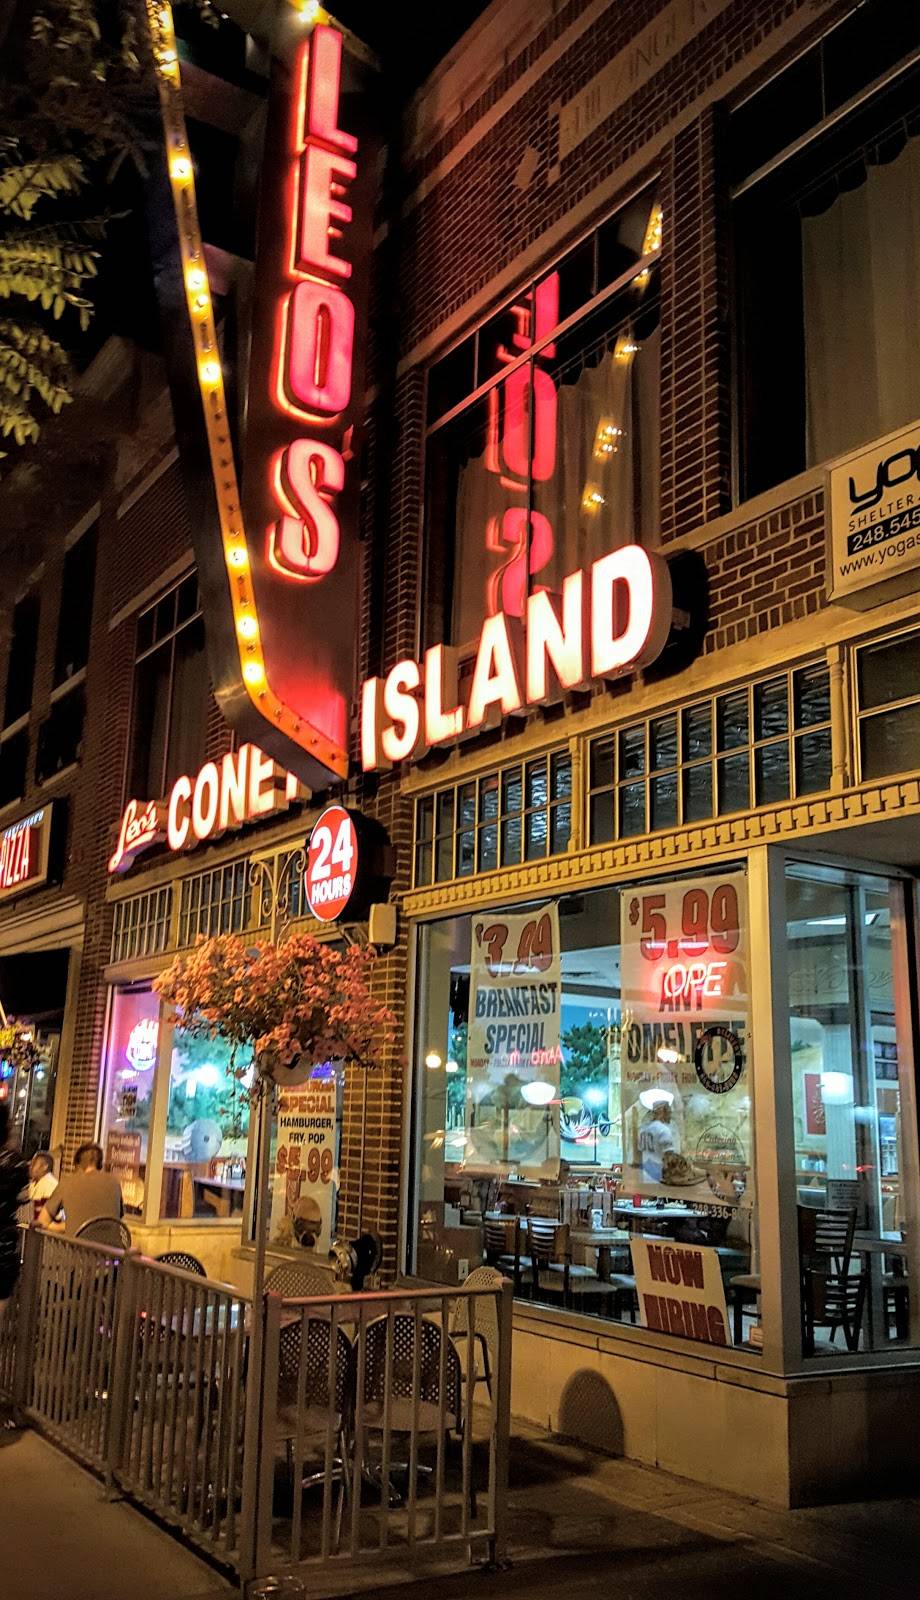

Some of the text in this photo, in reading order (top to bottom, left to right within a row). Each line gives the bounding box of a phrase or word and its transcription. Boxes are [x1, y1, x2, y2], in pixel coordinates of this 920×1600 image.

[849, 495, 915, 532] SHELTER
[361, 543, 656, 772] ISLAND
[108, 798, 159, 873] Leo's
[311, 817, 354, 881] 24
[311, 873, 352, 905] HOURS
[628, 883, 741, 962] $5.99
[475, 982, 557, 1018] BREAKFAST
[484, 1021, 546, 1054] SPECIAL
[278, 1095, 335, 1113] SPECIAL
[280, 1116, 334, 1131] HAMBURGER,
[308, 1132, 325, 1145] POP
[646, 1244, 704, 1289] NOW
[643, 1293, 728, 1345] HIRING
